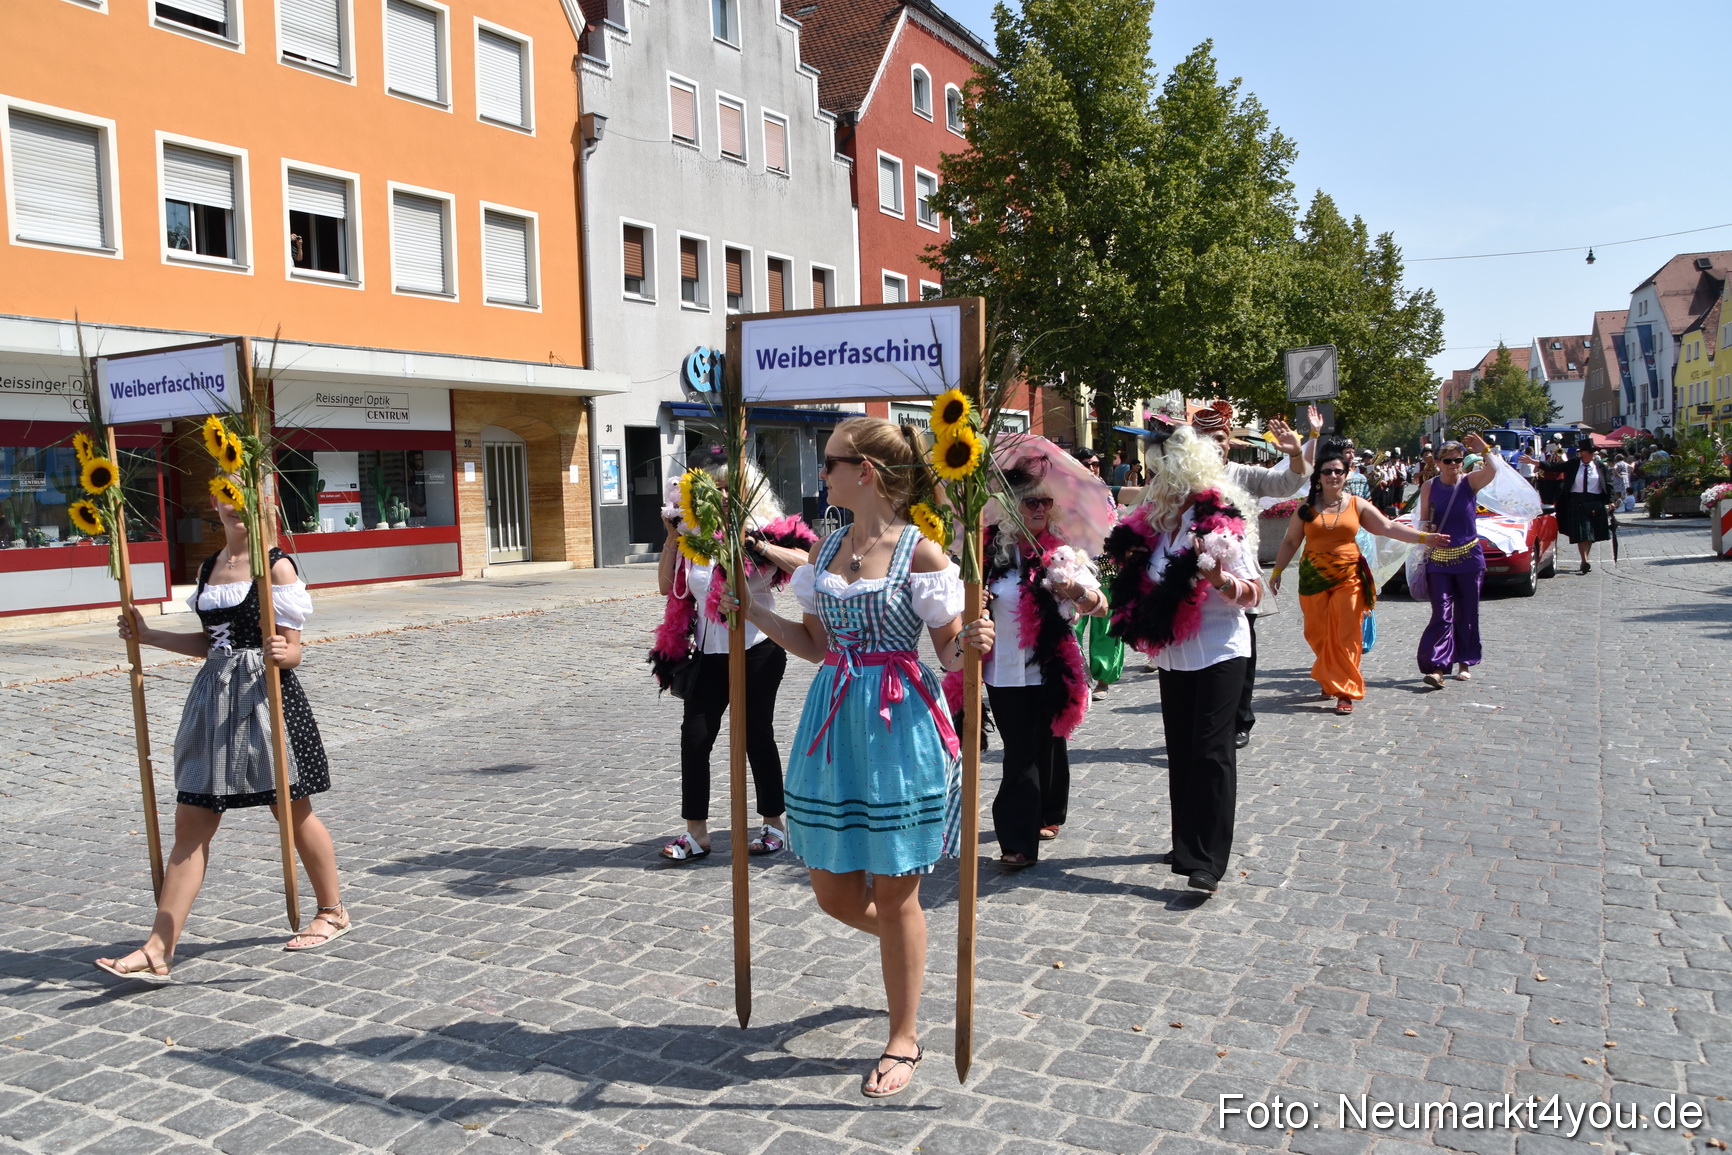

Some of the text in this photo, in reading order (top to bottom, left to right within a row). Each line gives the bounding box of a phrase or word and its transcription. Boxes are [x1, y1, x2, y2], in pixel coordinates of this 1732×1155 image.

[756, 338, 942, 370] Weiberfasching
[0, 376, 67, 393] eissinger
[110, 371, 225, 399] Weiberfasching
[316, 393, 390, 406] Reissinger Optik
[367, 410, 409, 420] CENTRUM
[606, 424, 613, 433] 31
[464, 439, 472, 448] 30
